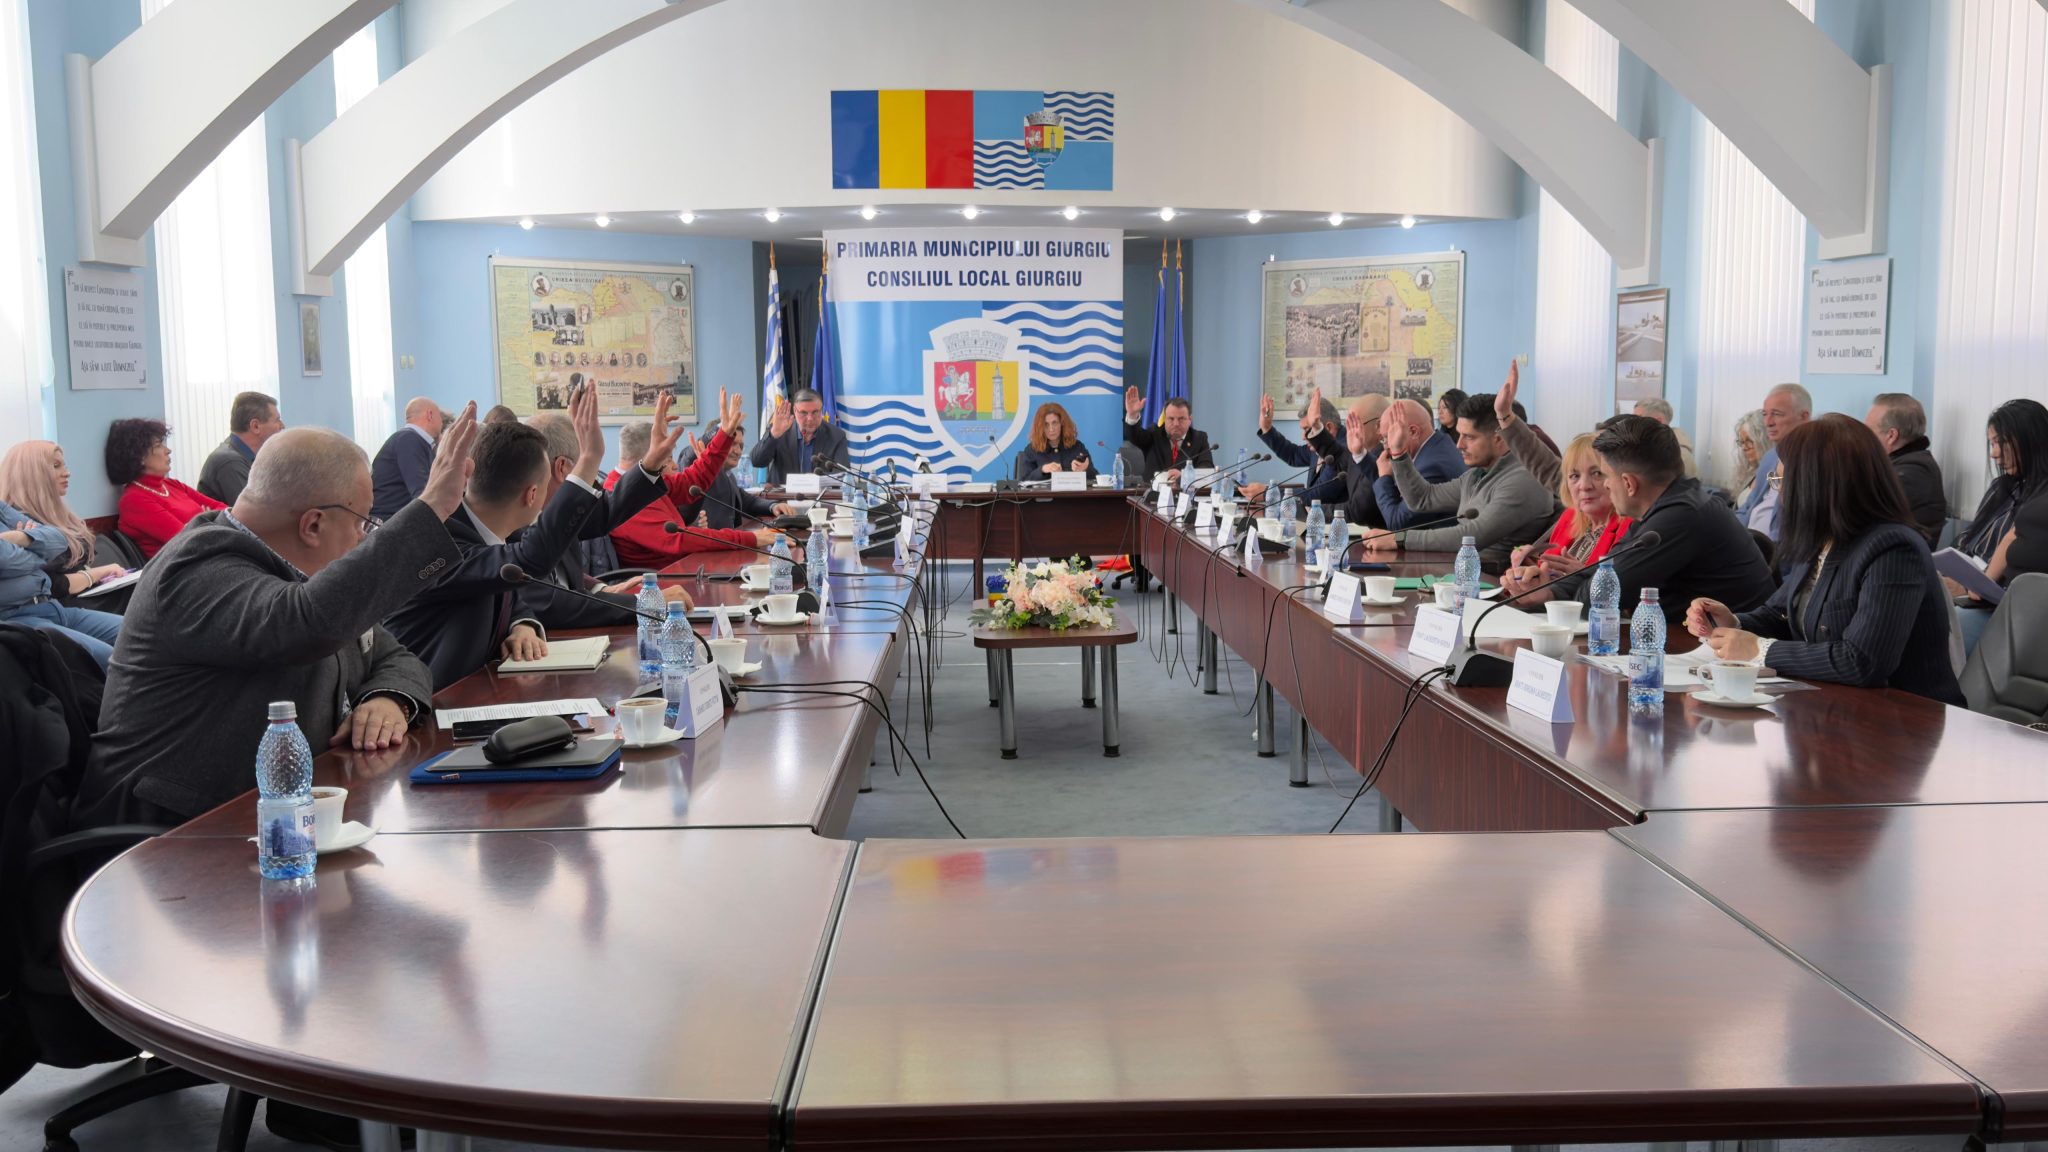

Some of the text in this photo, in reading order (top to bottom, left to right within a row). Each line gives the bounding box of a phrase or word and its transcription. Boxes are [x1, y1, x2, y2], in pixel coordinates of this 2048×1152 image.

[837, 240, 1111, 259] PRIMARIA MUNICIPIULUI GIURGIU
[867, 270, 1083, 287] CONSILIUL LOCAL GIURGIU
